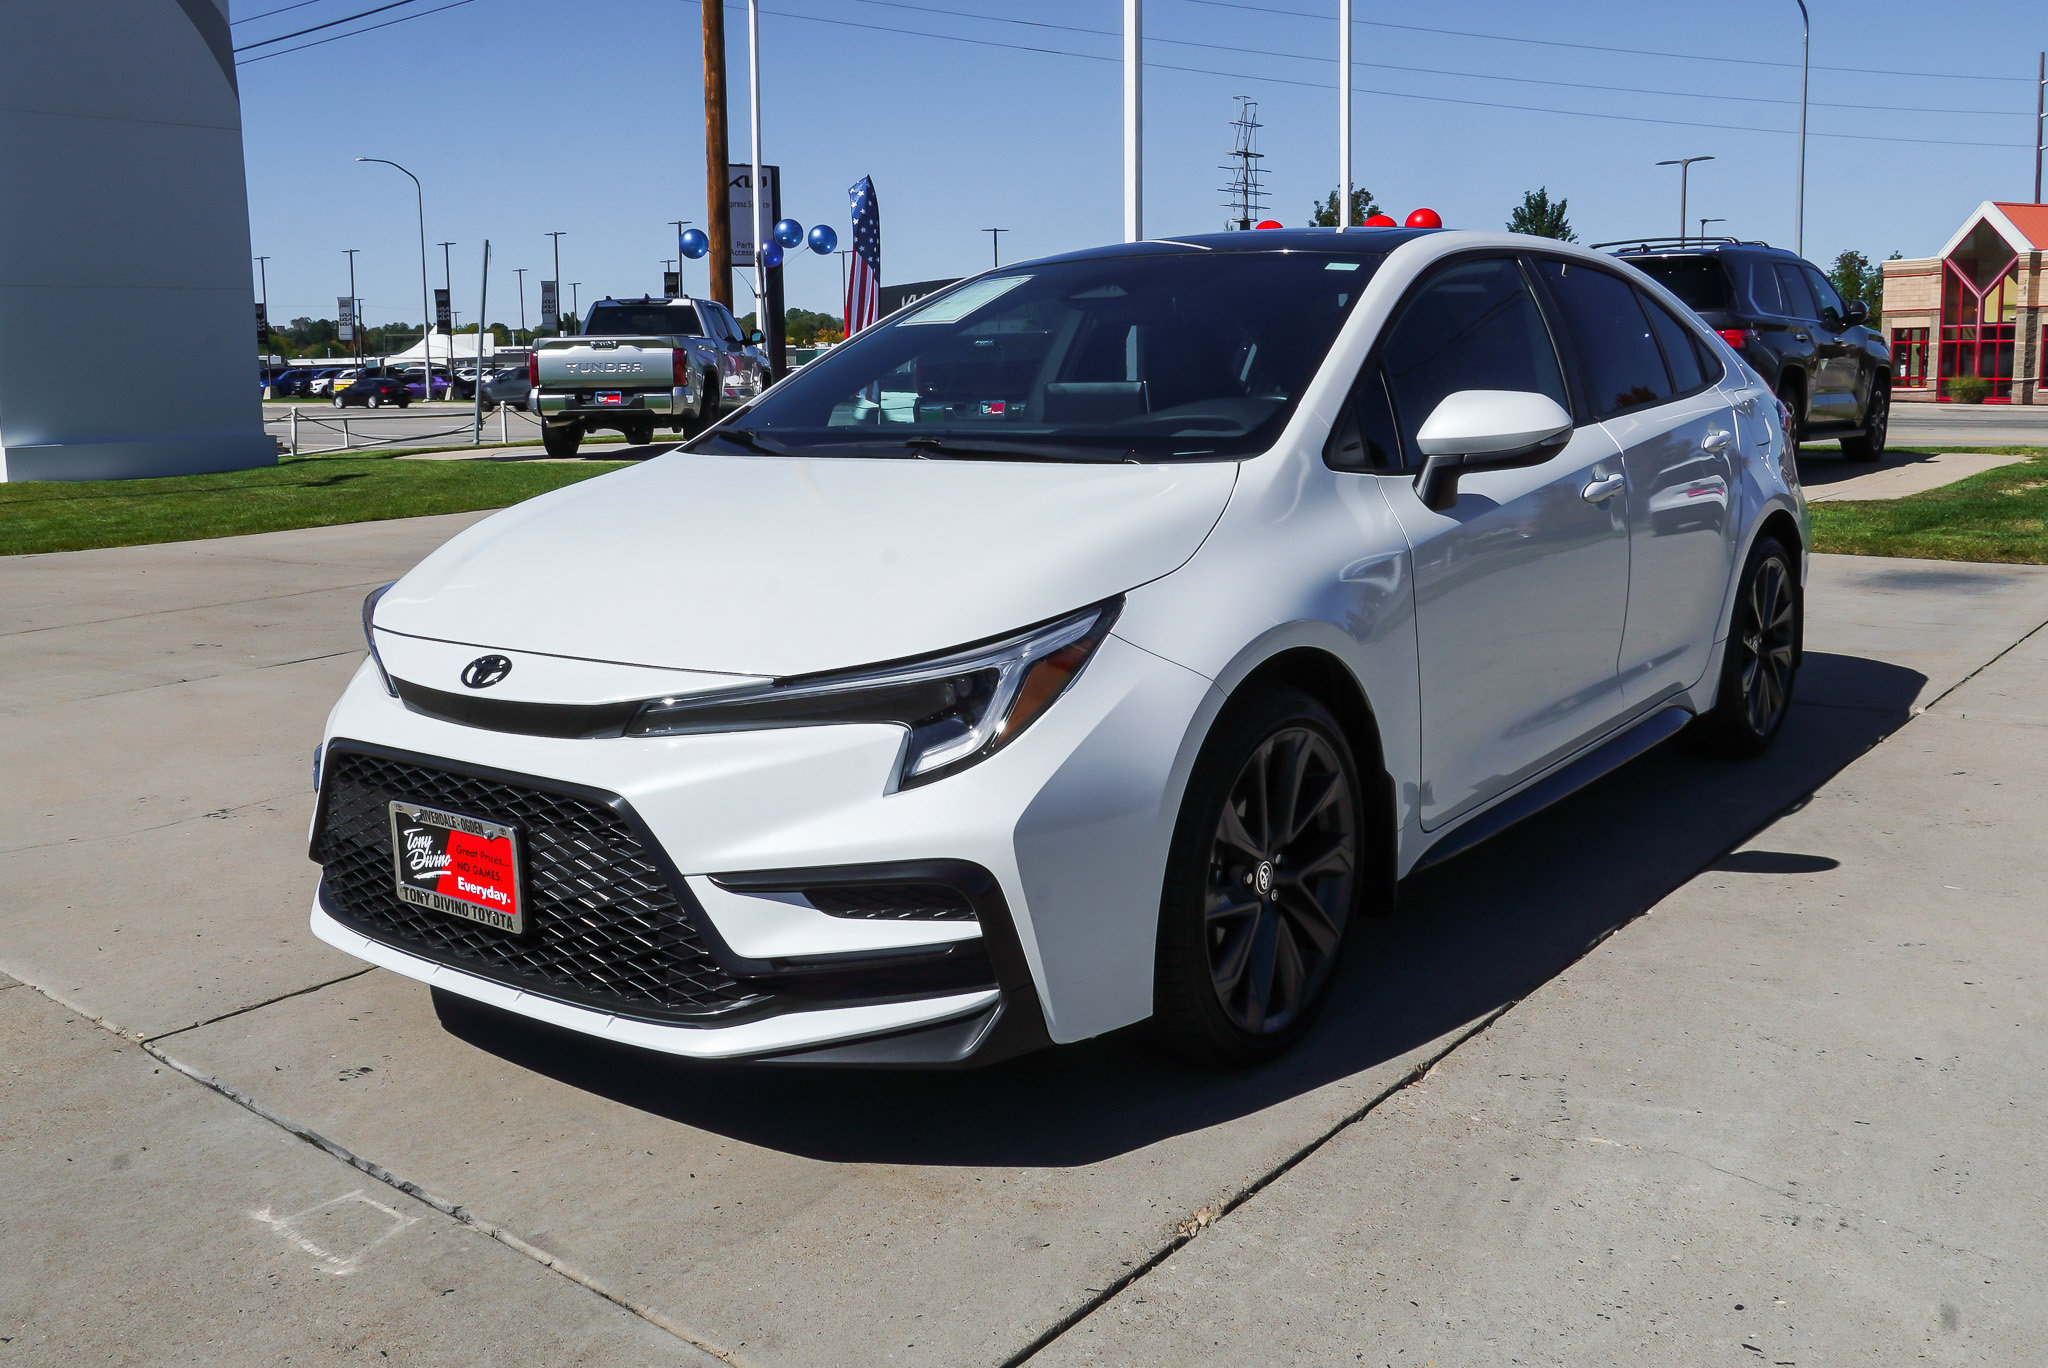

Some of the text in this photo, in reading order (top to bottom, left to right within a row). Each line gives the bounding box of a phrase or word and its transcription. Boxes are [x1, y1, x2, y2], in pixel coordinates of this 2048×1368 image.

[730, 201, 747, 209] press
[566, 362, 644, 374] TUNDRA
[419, 808, 458, 829] RIVERDALE
[460, 817, 484, 836] OGDEN
[403, 827, 434, 855] Tony
[456, 845, 478, 858] Great
[405, 848, 453, 871] Divino
[457, 861, 504, 883] NO GAMES.
[457, 876, 511, 905] Everyday.
[403, 887, 514, 931] TONY DIVINO TOYOTA
